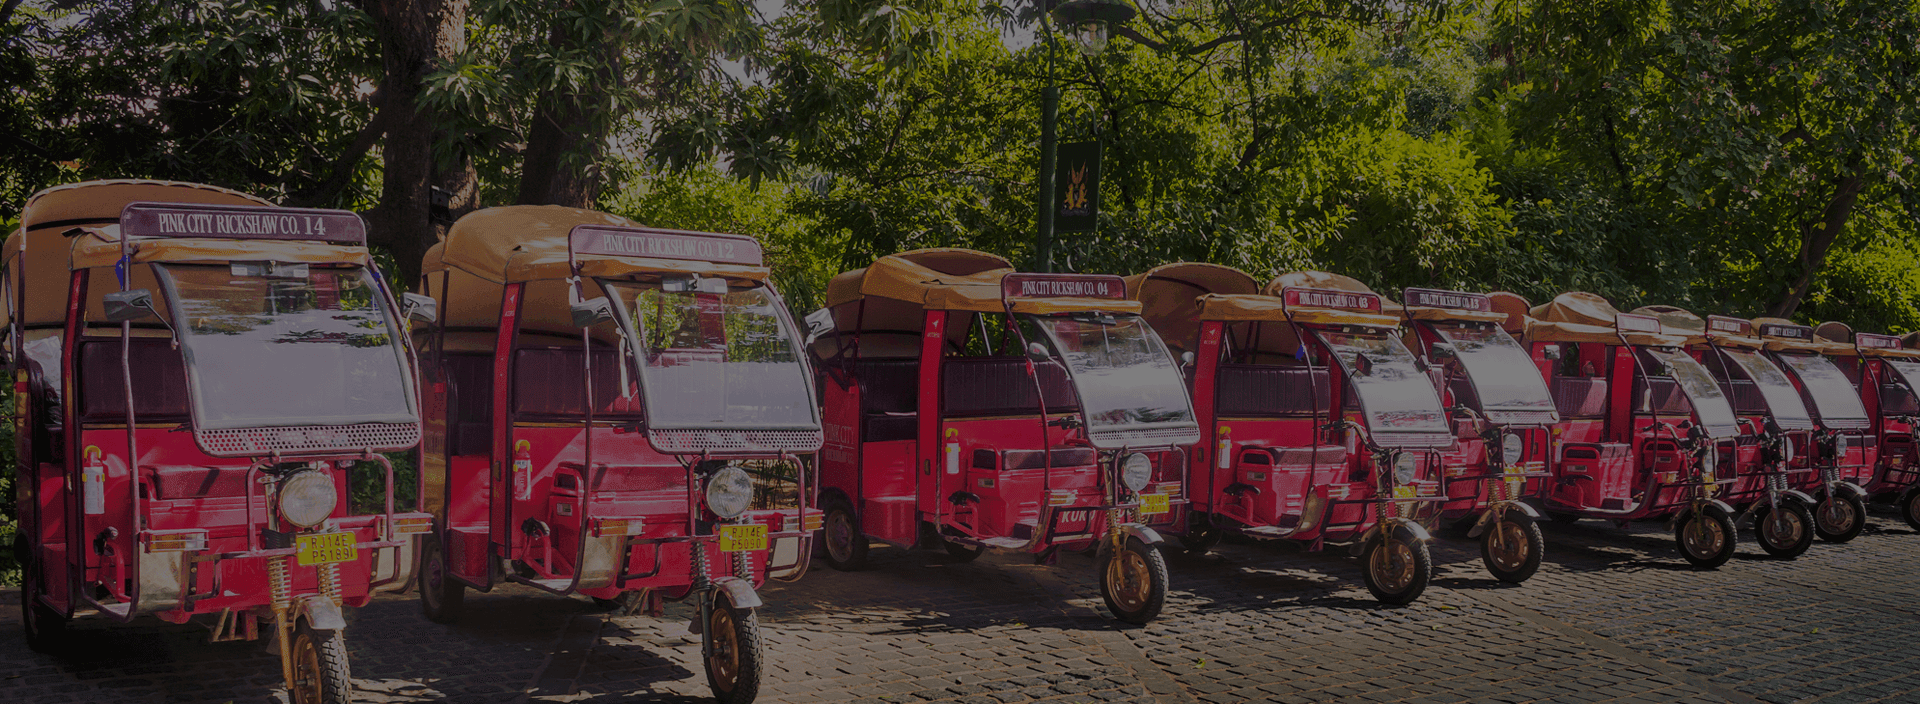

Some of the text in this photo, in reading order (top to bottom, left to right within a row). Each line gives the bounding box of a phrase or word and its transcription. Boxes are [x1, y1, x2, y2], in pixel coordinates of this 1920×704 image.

[158, 212, 326, 236] PINK CITY RICKSHAW CO. 14
[603, 234, 735, 259] PINK CITY RICKSHAW CO. 12
[1022, 281, 1036, 296] PINK
[1036, 281, 1050, 295] CITY
[1051, 281, 1084, 296] RICKSHAW
[1097, 282, 1109, 296] 04
[1310, 293, 1322, 306] CITY
[1358, 296, 1369, 309] 03
[1470, 297, 1479, 309] 13
[733, 526, 762, 538] RJ14E
[311, 533, 348, 549] RJ14E
